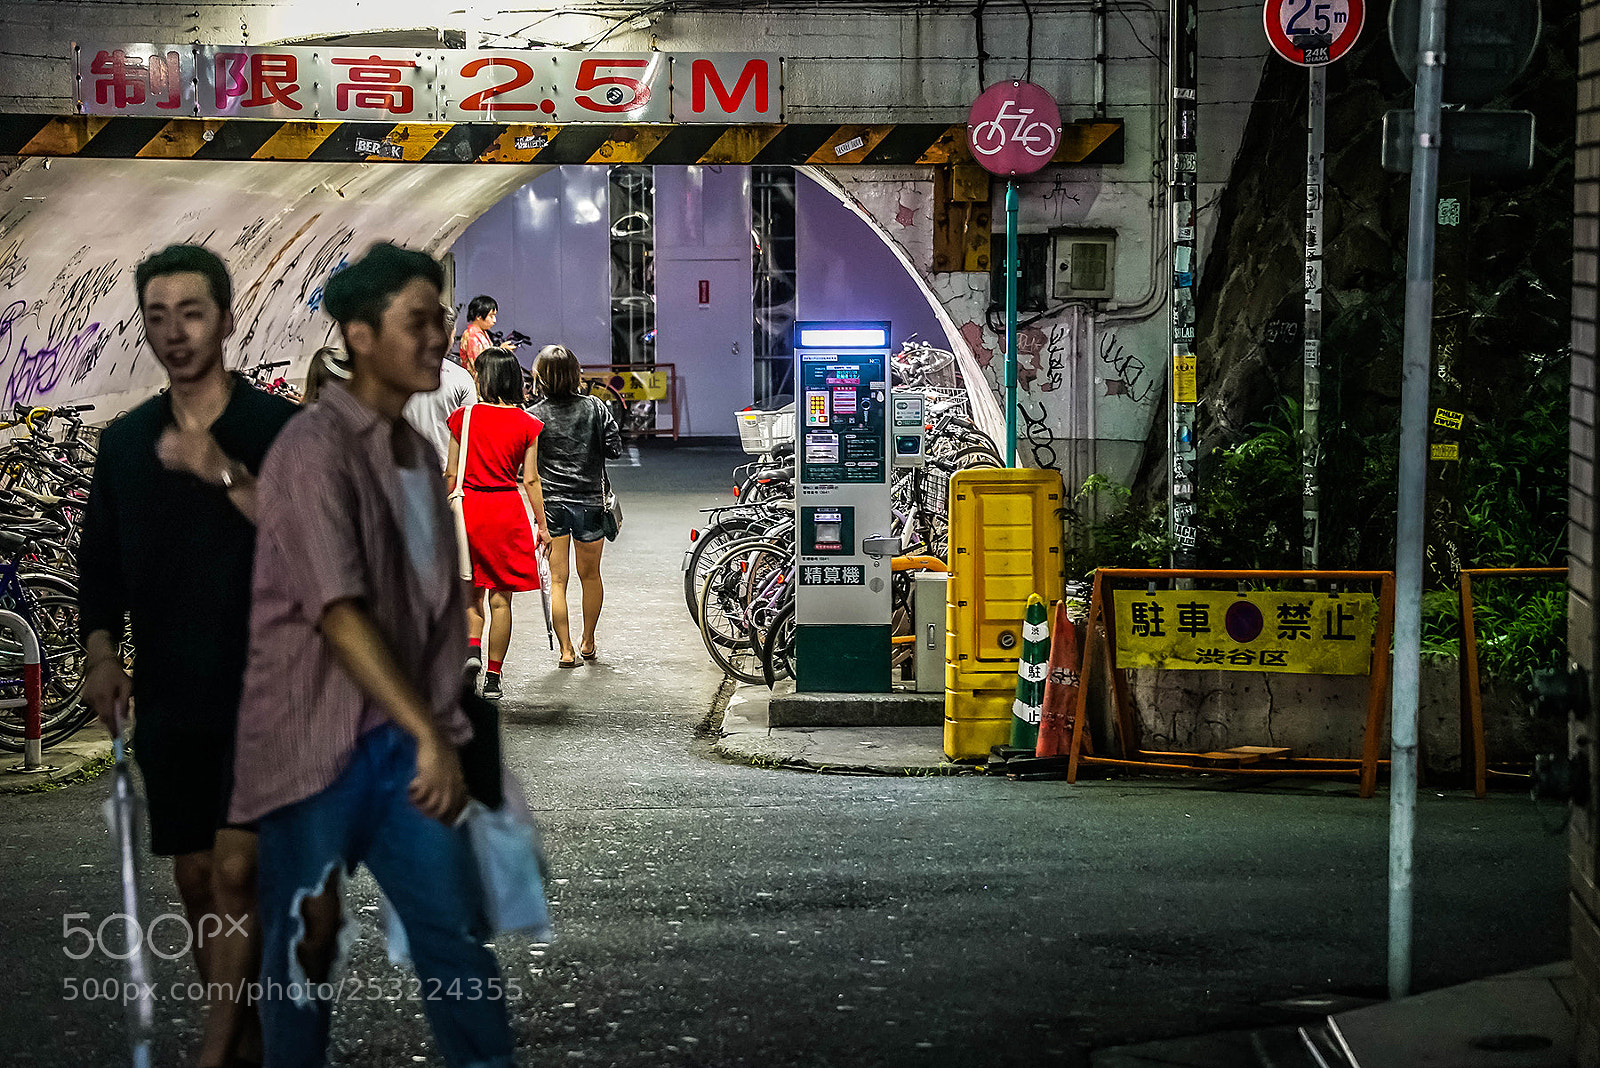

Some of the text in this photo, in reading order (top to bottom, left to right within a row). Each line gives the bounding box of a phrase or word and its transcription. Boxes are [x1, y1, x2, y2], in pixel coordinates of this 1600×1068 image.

[804, 566, 860, 584] 精算機
[1195, 648, 1289, 667] 渋谷区
